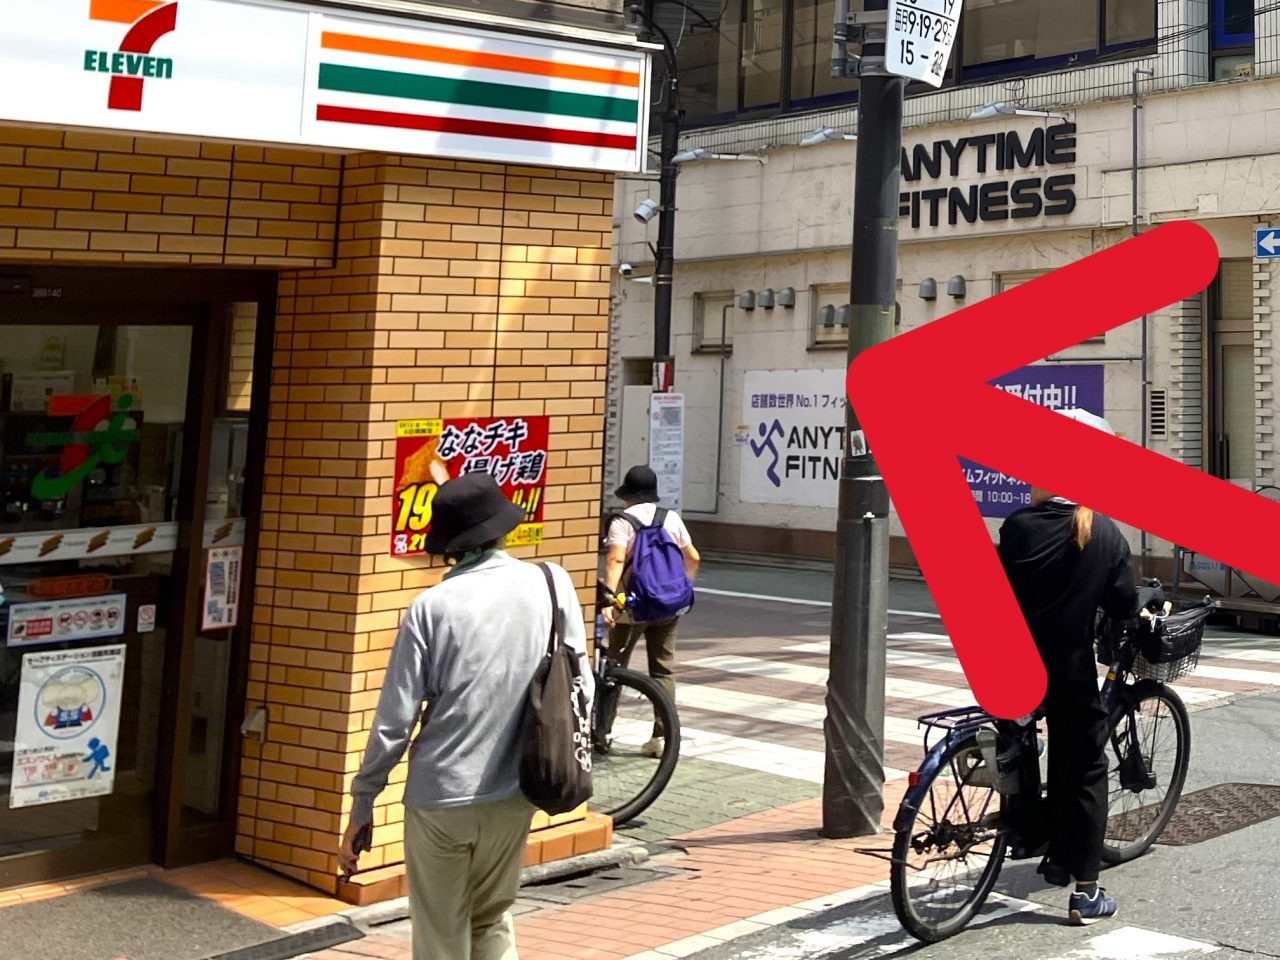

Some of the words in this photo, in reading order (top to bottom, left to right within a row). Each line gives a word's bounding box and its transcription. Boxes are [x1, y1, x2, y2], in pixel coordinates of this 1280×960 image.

[751, 393, 794, 408] 店舗数世界
[796, 394, 818, 408] No.1
[995, 384, 1077, 411] 付中!!
[437, 421, 526, 458] ななチキ
[785, 455, 840, 480] FITN
[962, 468, 1027, 485] ムフィット
